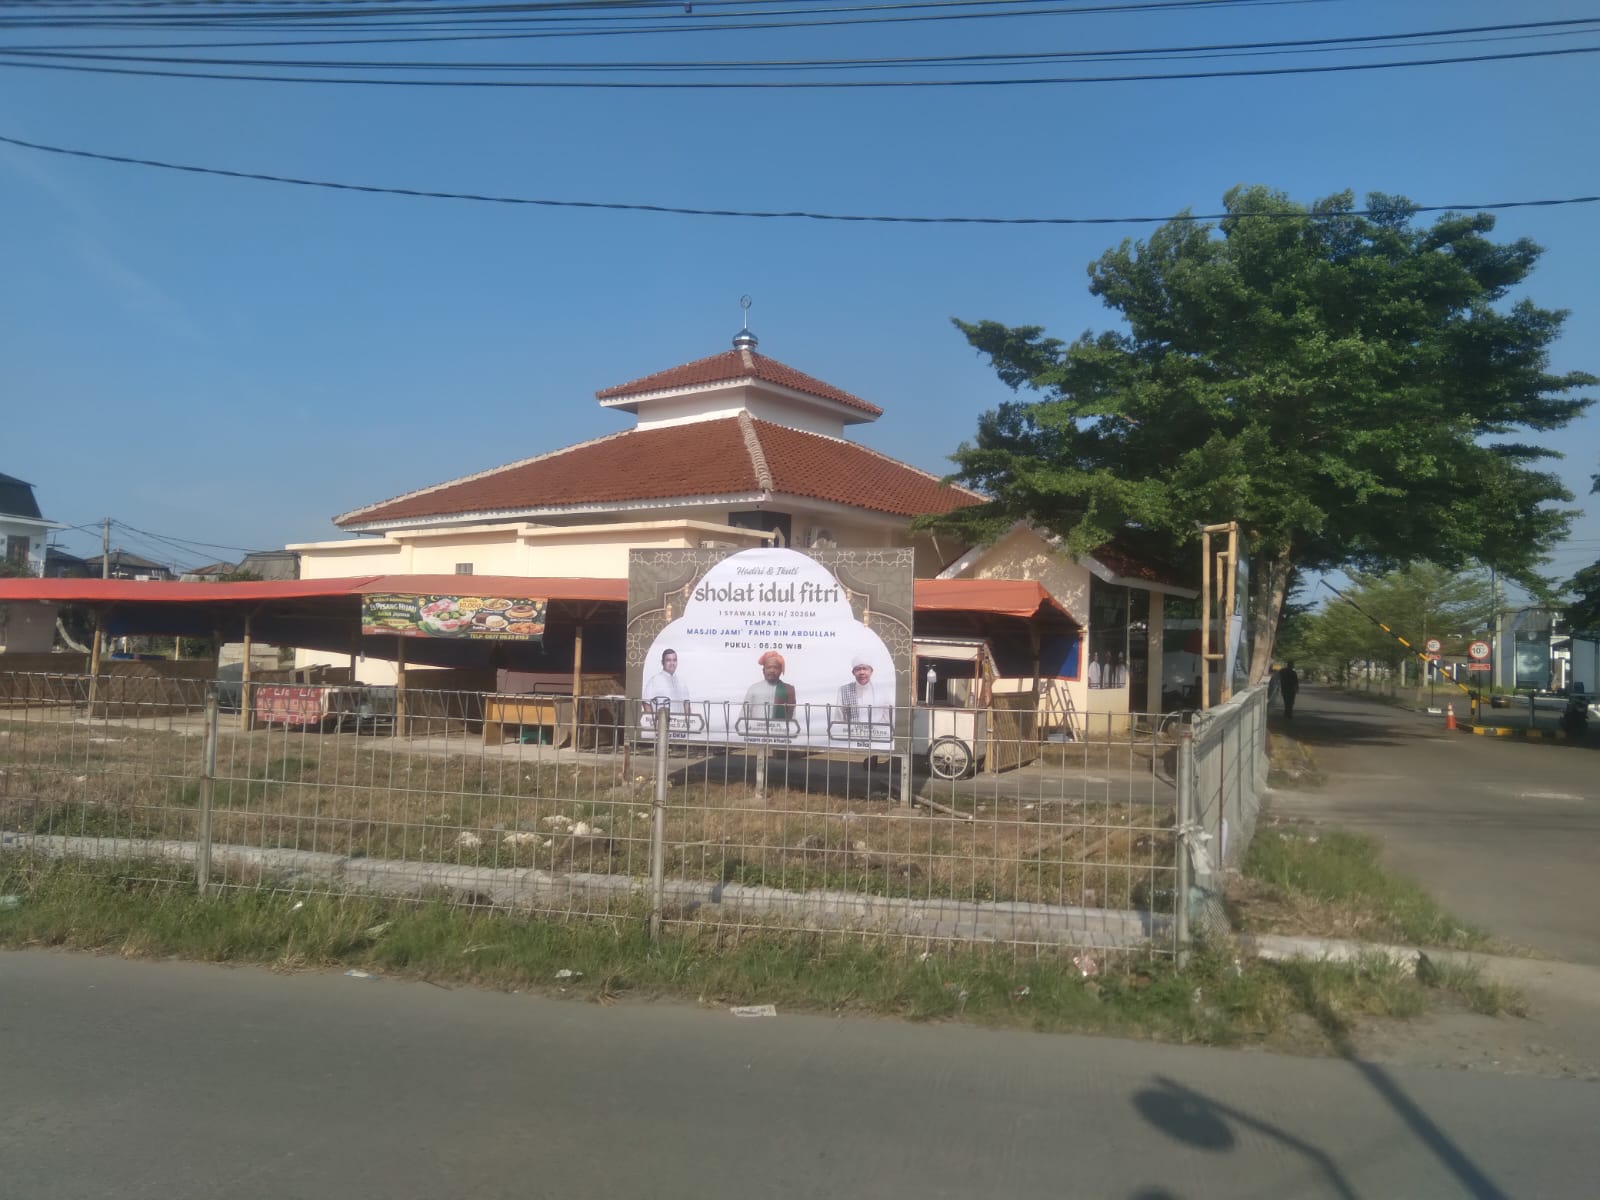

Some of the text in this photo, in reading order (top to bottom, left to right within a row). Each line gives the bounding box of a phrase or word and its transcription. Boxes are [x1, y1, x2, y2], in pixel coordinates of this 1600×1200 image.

[736, 566, 800, 576] Hadiri & Ikuti
[694, 581, 839, 605] sholat idul fitri
[1472, 646, 1481, 656] 10
